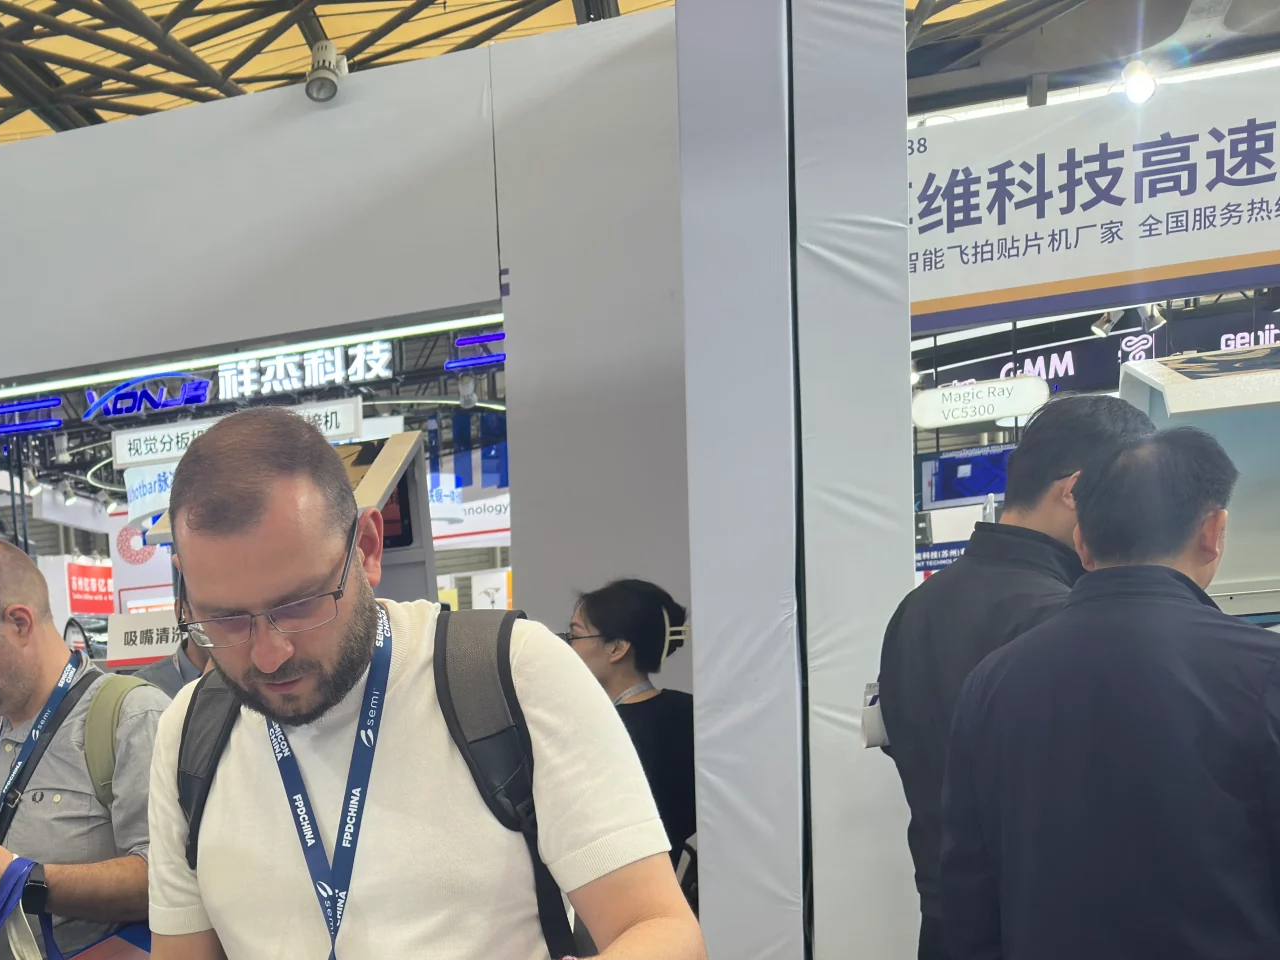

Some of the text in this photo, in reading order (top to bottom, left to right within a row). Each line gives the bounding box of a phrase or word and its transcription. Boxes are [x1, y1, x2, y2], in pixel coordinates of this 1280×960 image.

[909, 117, 1278, 236] 维科技高速
[218, 341, 393, 400] 祥杰科技
[941, 384, 1014, 406] Magic Ray
[941, 403, 995, 421] VC5300
[366, 687, 381, 727] semi
[268, 728, 283, 762] CHINA
[292, 793, 316, 848] FPDCHINA
[341, 786, 362, 848] FPDCHINA
